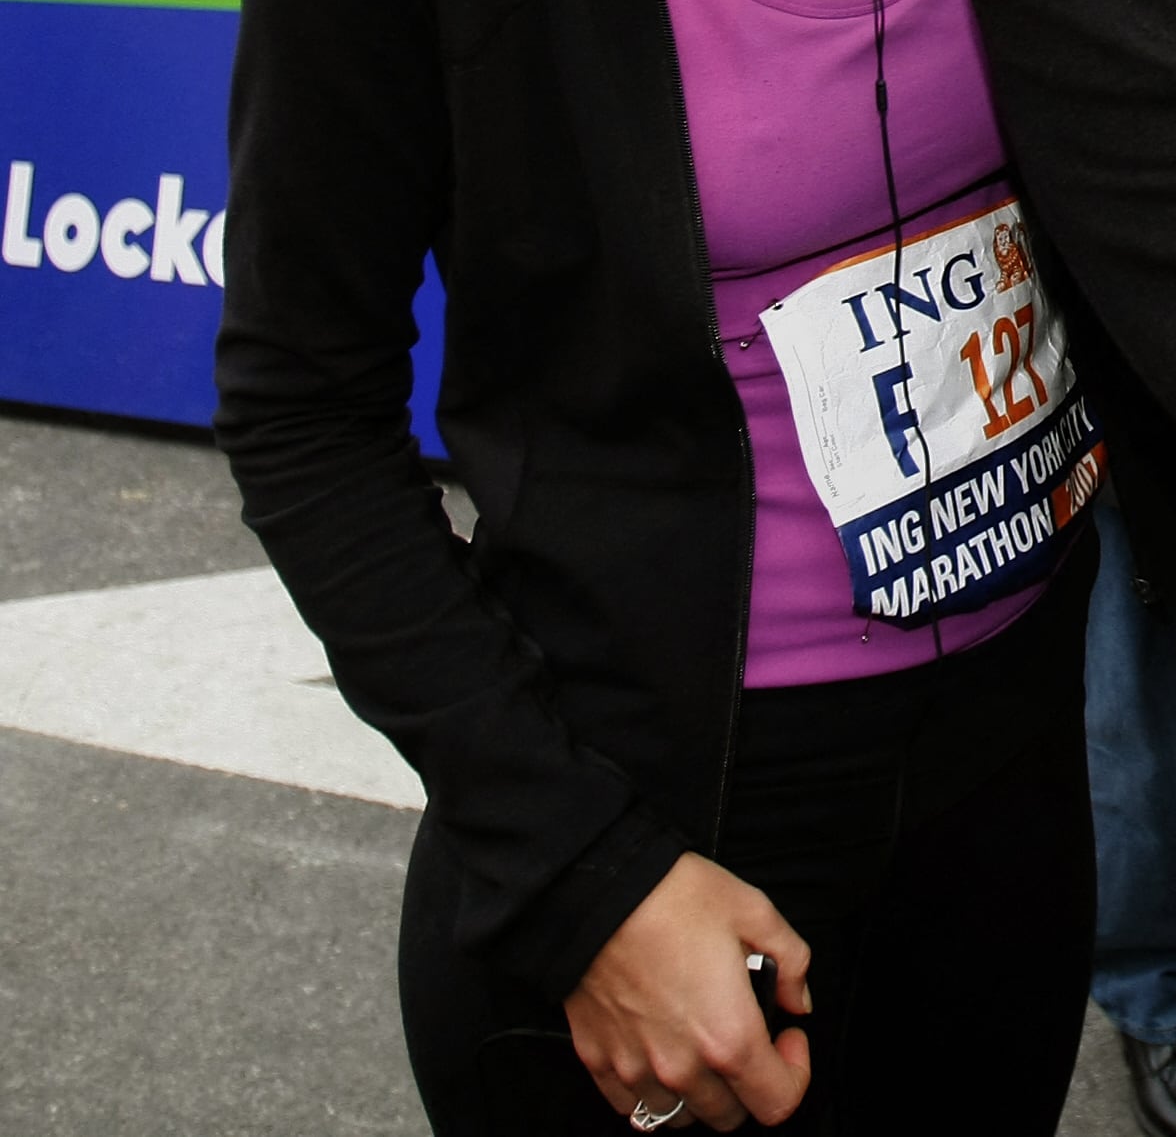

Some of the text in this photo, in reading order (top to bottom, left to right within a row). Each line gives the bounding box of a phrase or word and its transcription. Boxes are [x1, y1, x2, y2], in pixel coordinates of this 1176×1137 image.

[841, 249, 987, 353] ING
[872, 361, 921, 479] F
[960, 302, 1049, 441] 127
[858, 397, 1094, 577] ING NEW YORK CITY
[870, 496, 1054, 618] MARATHON
